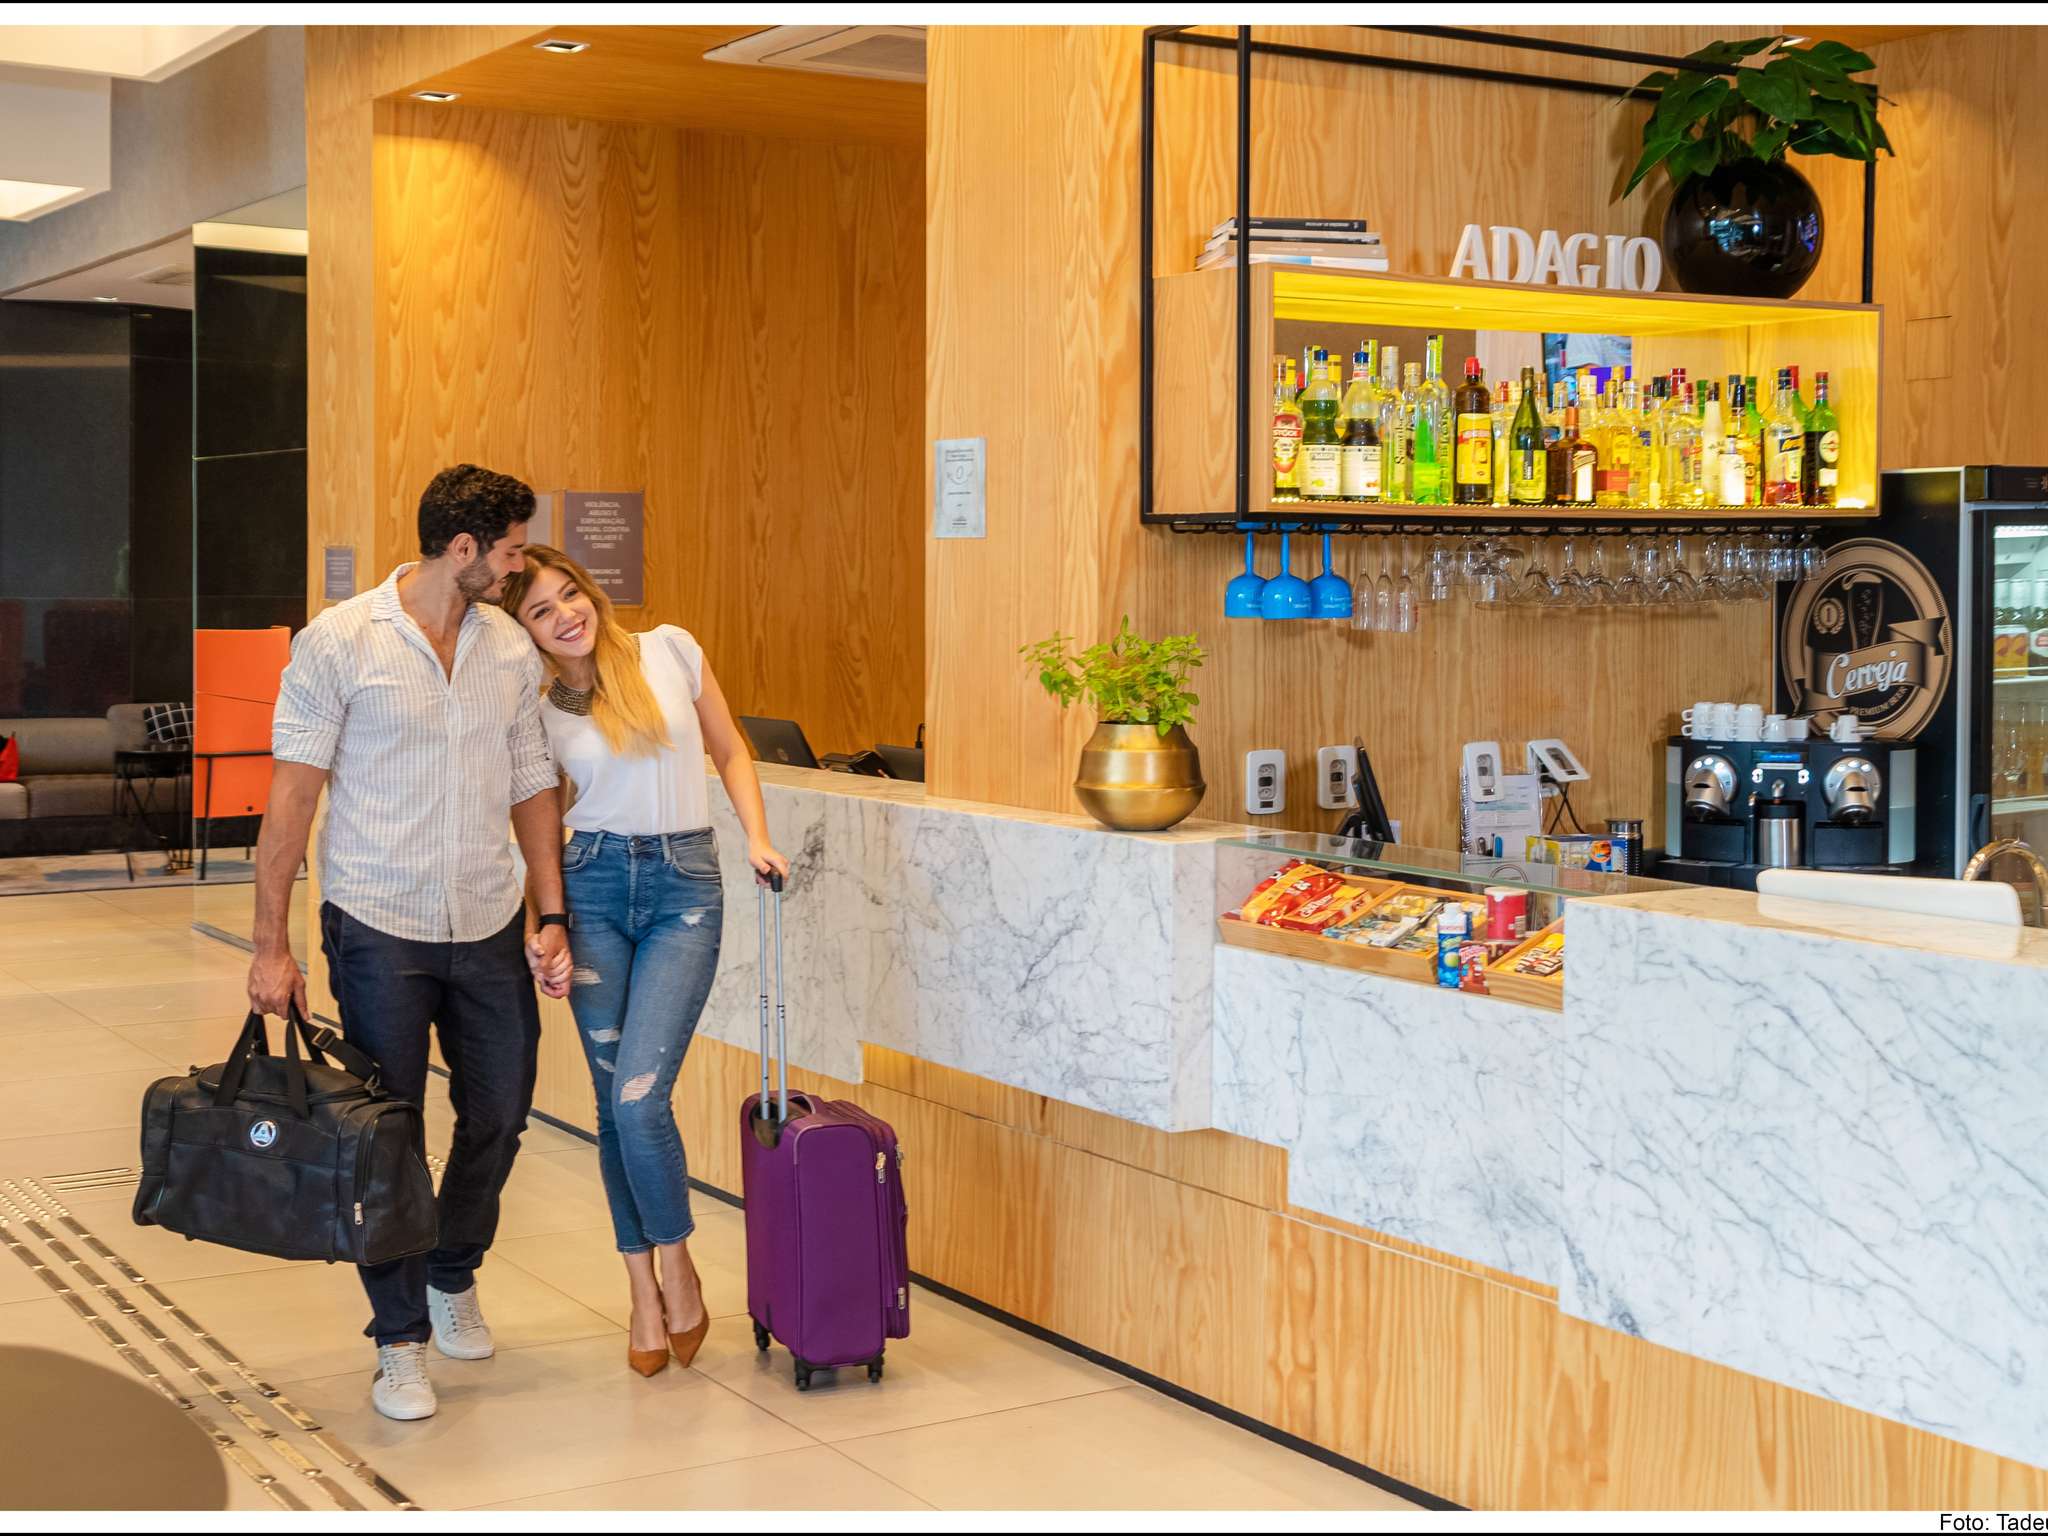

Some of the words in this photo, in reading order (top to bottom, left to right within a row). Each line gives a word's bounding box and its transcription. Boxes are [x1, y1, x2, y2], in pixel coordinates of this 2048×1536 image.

[1449, 223, 1663, 293] ADAGIO
[1826, 649, 1909, 699] Cerveja
[1849, 703, 1890, 717] PREMIUM
